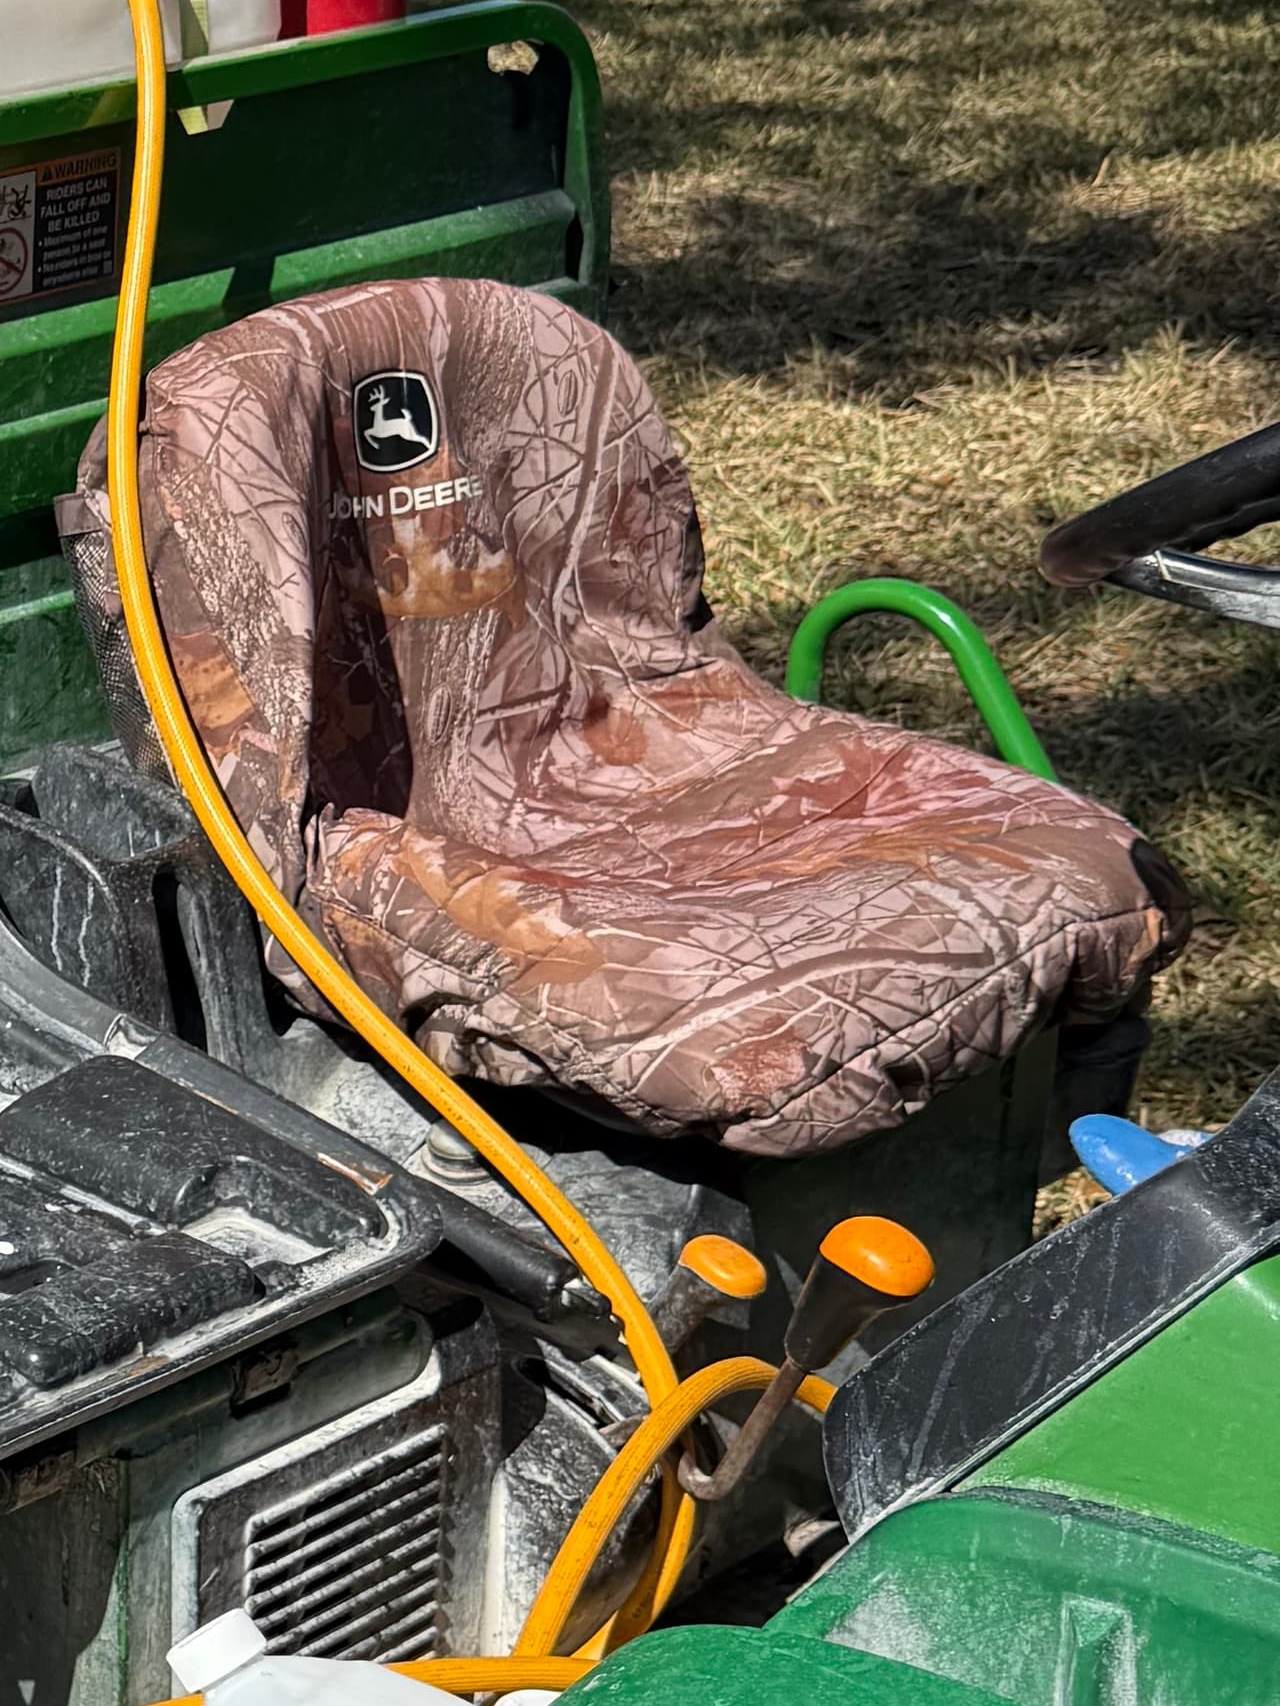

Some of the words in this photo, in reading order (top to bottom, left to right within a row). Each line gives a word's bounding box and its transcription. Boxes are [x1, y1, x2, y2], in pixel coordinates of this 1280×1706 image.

[55, 153, 117, 176] WARNING
[46, 184, 84, 201] RIDERS
[85, 177, 108, 193] CAN
[40, 204, 65, 219] FALL
[67, 198, 87, 213] OFF
[88, 192, 111, 207] AND
[47, 219, 62, 233] BE
[64, 210, 100, 229] KILLED
[328, 493, 384, 520] JOHN
[389, 475, 483, 515] DEERE
